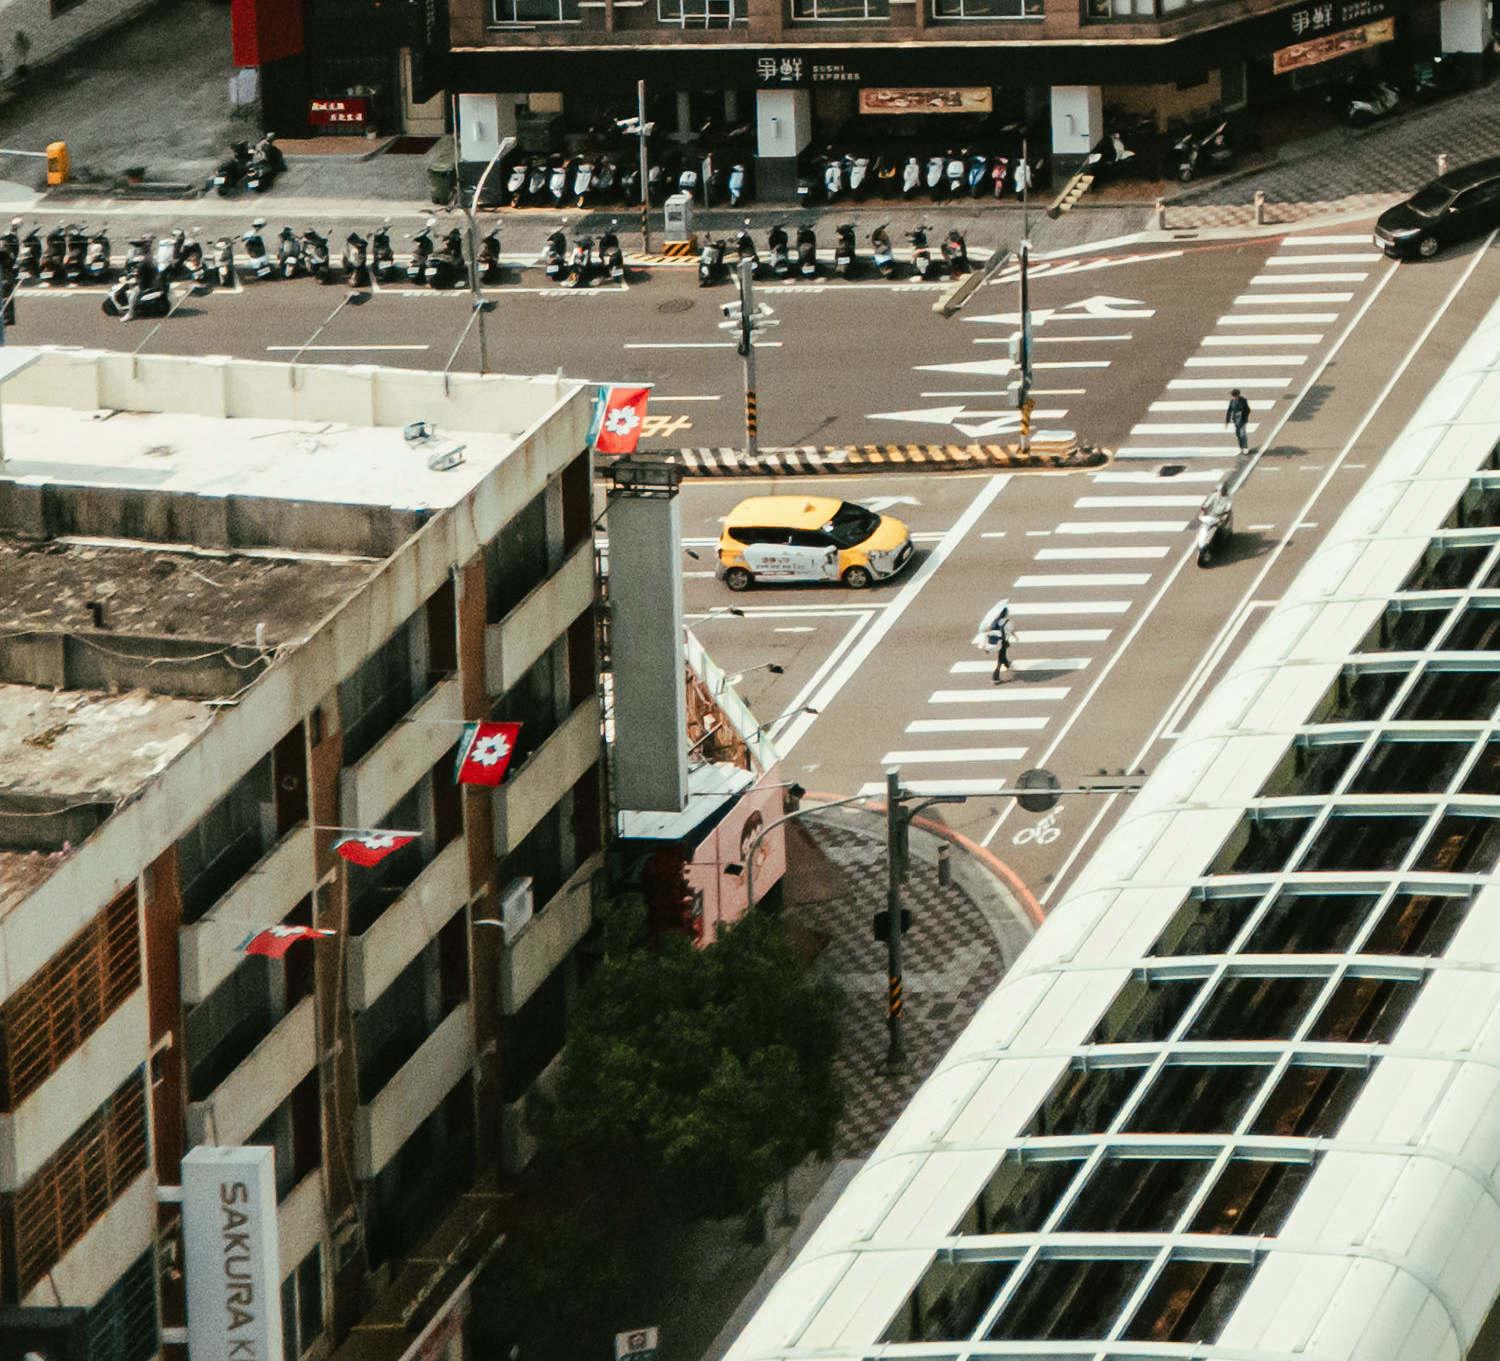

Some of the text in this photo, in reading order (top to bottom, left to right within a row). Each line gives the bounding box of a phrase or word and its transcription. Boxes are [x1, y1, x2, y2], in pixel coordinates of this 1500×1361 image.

[1291, 4, 1334, 35] 爭鮮
[756, 57, 844, 81] 爭鮮 SUSHI
[813, 73, 860, 81] EXPRESS
[220, 1182, 255, 1331] SAKURA
